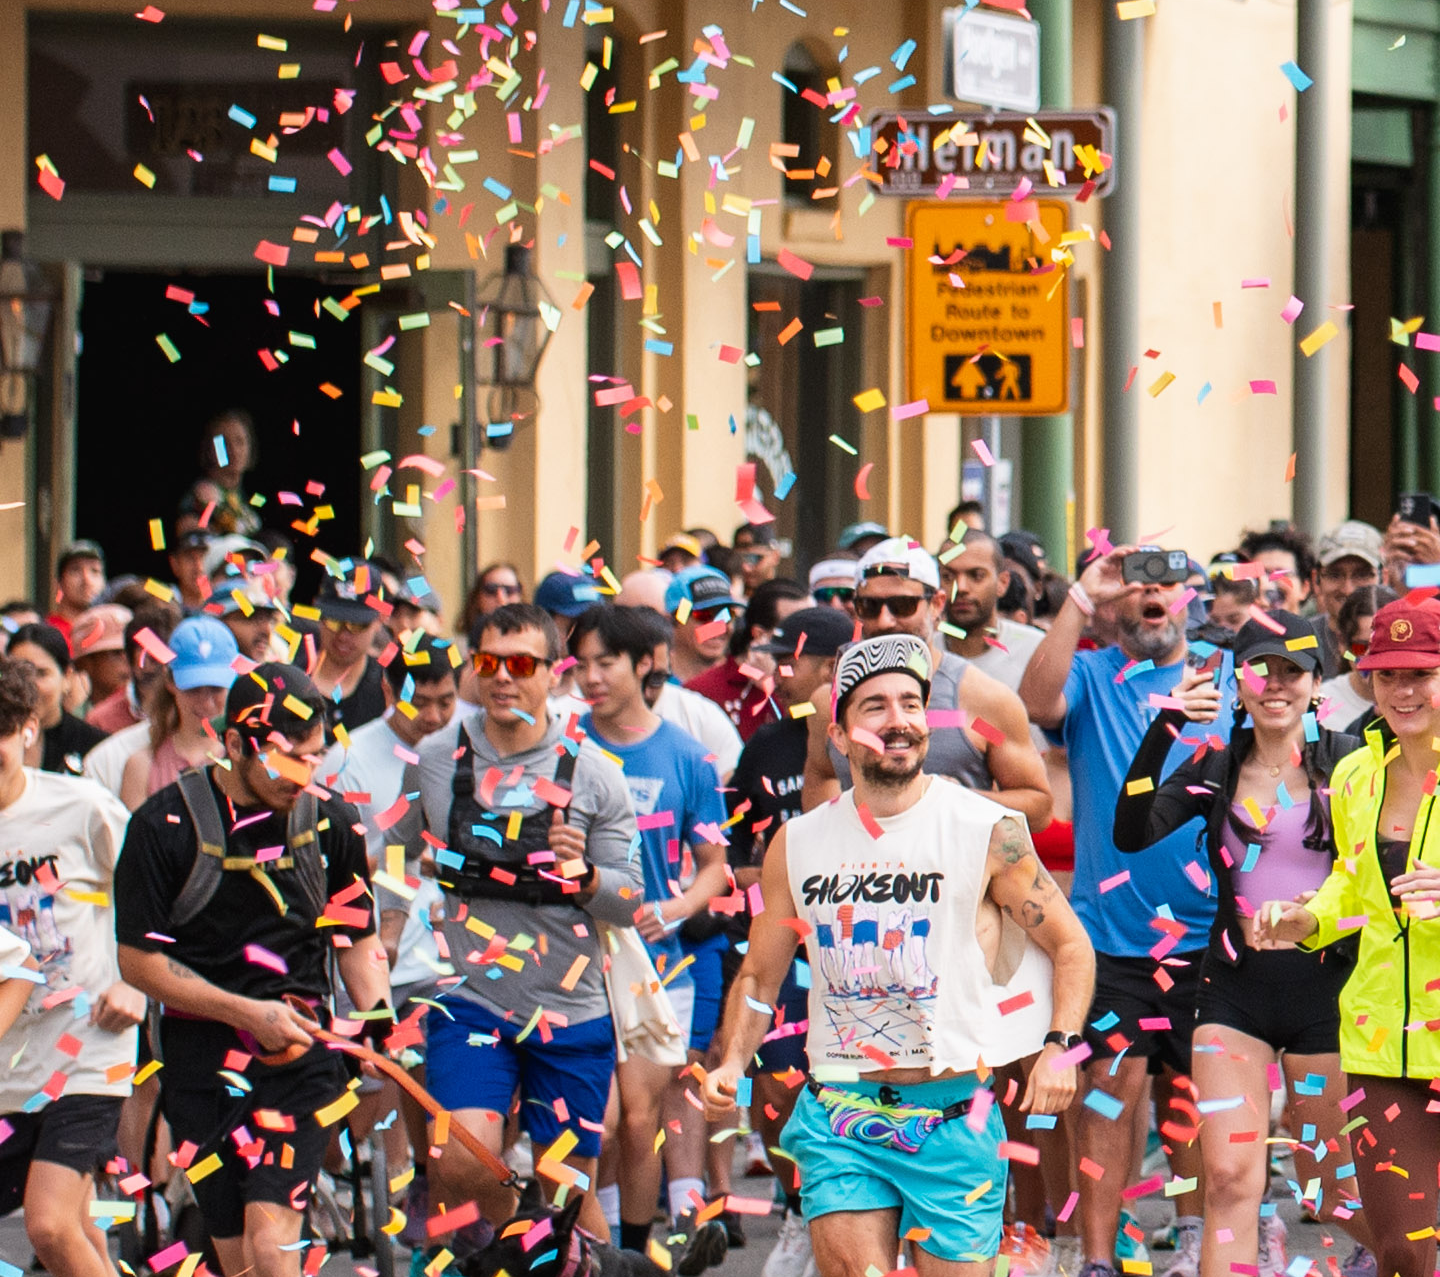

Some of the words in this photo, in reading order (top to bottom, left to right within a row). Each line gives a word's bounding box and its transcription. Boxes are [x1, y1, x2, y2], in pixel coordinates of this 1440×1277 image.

[937, 282, 1039, 298] Pedestrian
[946, 304, 1001, 319] Route
[1011, 304, 1030, 319] to
[931, 325, 1044, 342] Downtown
[802, 872, 944, 906] SHAKEOUT
